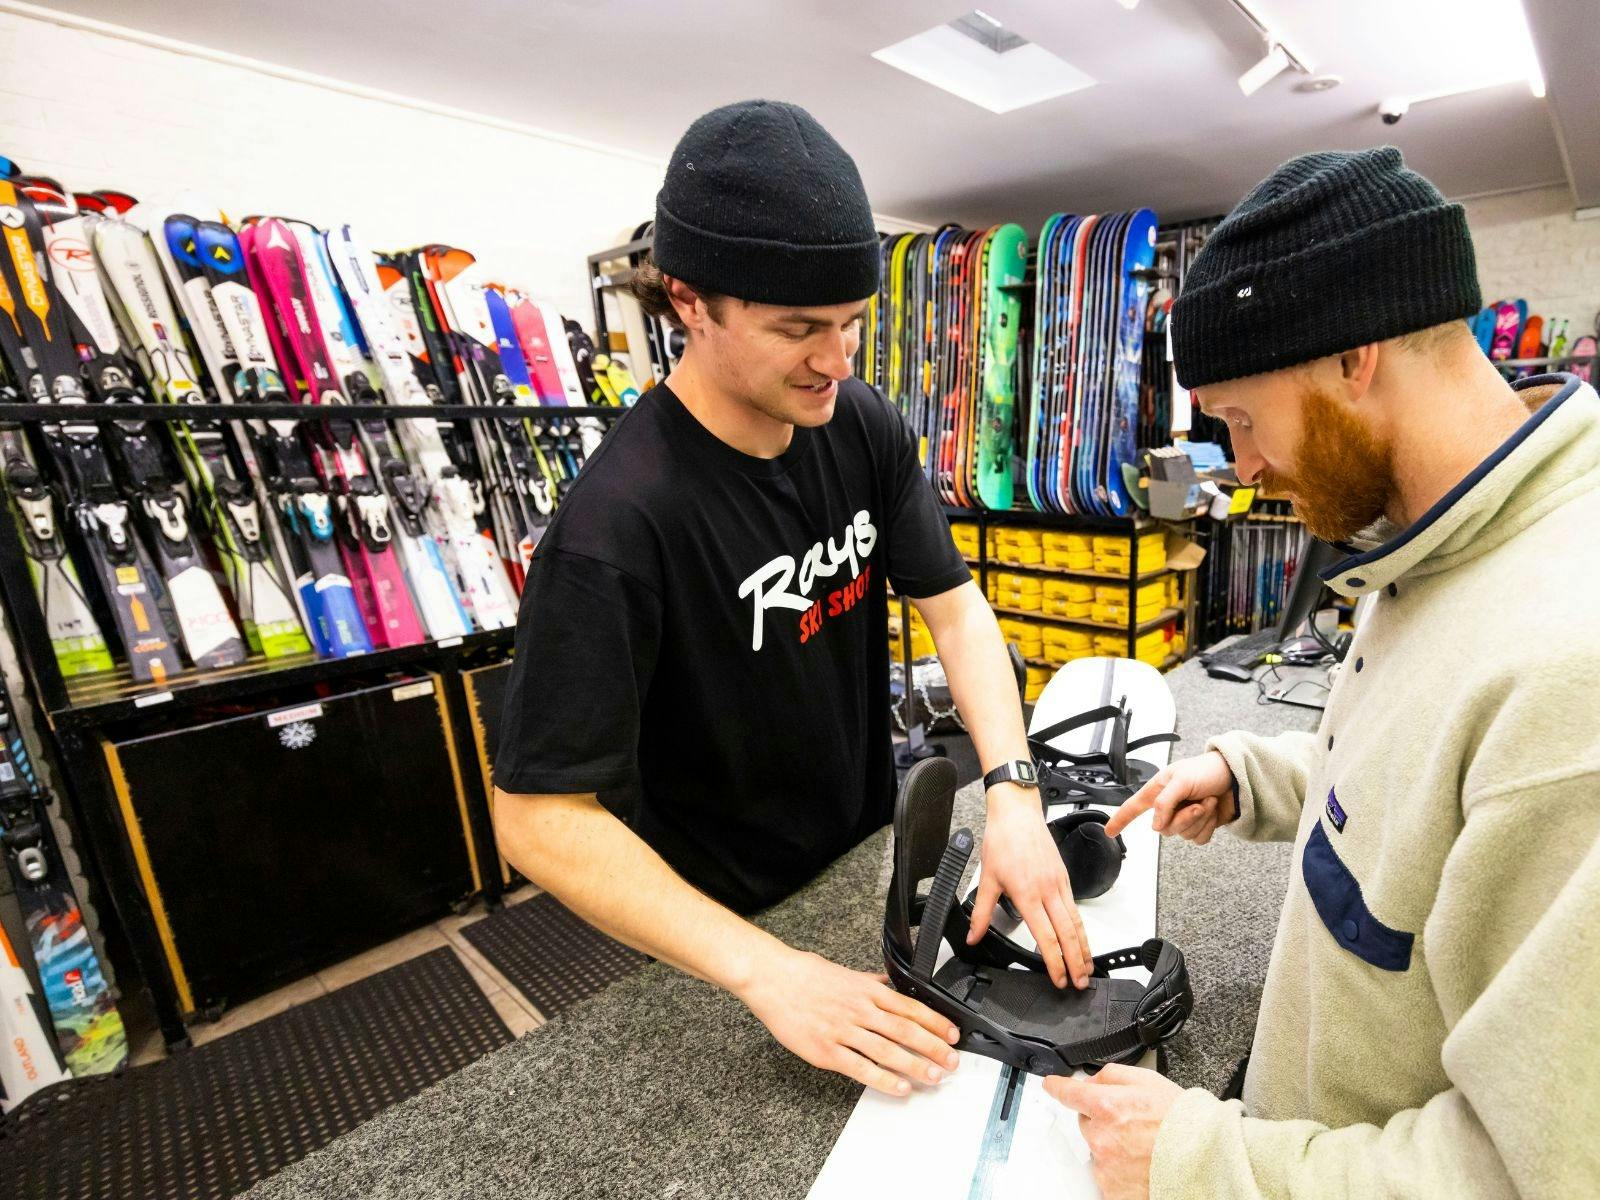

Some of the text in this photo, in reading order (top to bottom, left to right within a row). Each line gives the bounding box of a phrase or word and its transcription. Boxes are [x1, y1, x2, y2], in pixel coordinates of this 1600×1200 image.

[738, 509, 878, 652] Rays
[799, 599, 823, 644] SKI
[15, 1038, 37, 1080] OUTLAND
